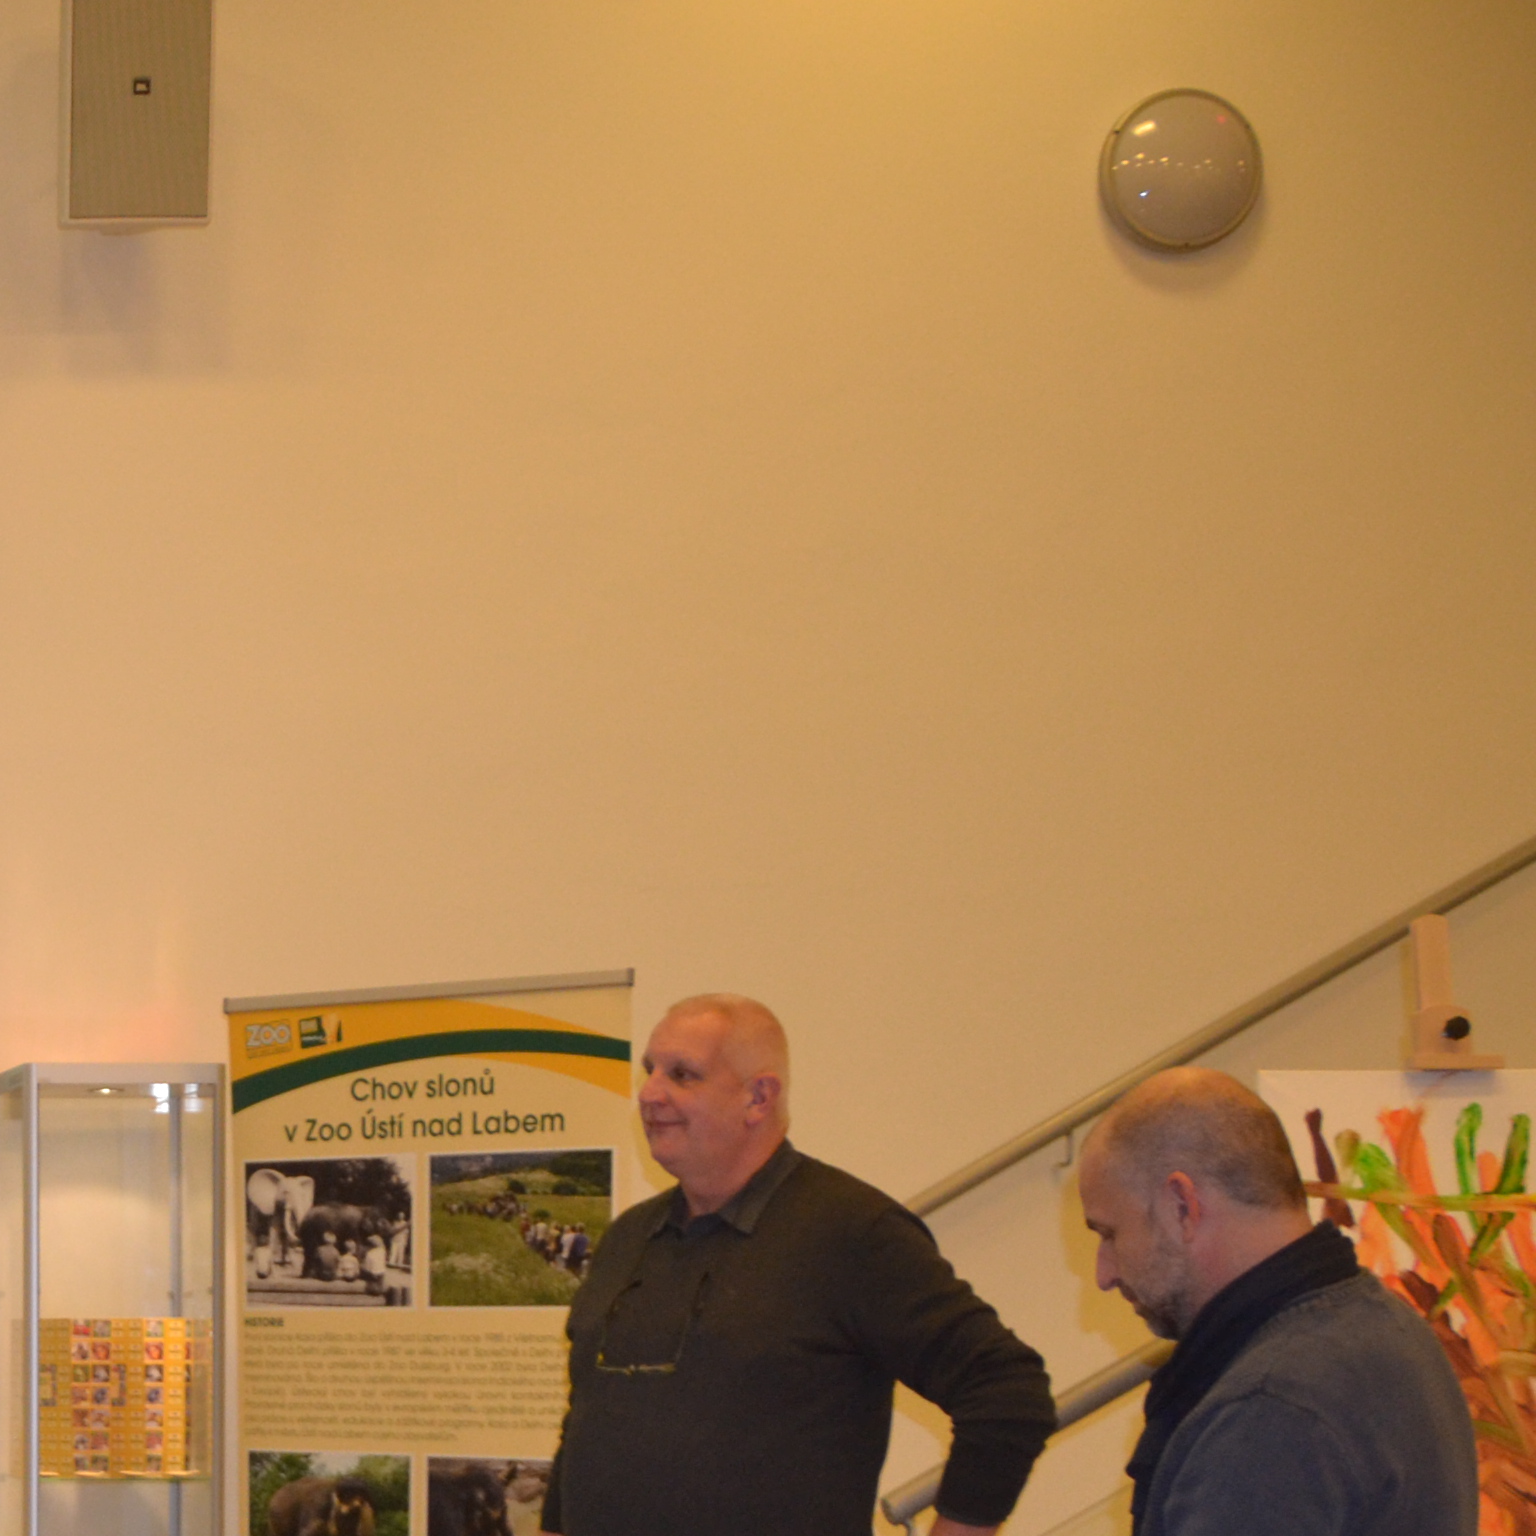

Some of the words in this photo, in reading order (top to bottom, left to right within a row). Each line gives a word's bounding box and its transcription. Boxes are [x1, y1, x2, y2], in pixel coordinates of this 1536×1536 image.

[245, 1023, 291, 1049] ZOO
[350, 1077, 418, 1102] Chov
[425, 1068, 495, 1098] slonů
[283, 1124, 298, 1143] v
[305, 1118, 352, 1142] Zoo
[361, 1108, 404, 1140] Ústí
[411, 1112, 463, 1138] nad
[472, 1109, 566, 1136] Labem
